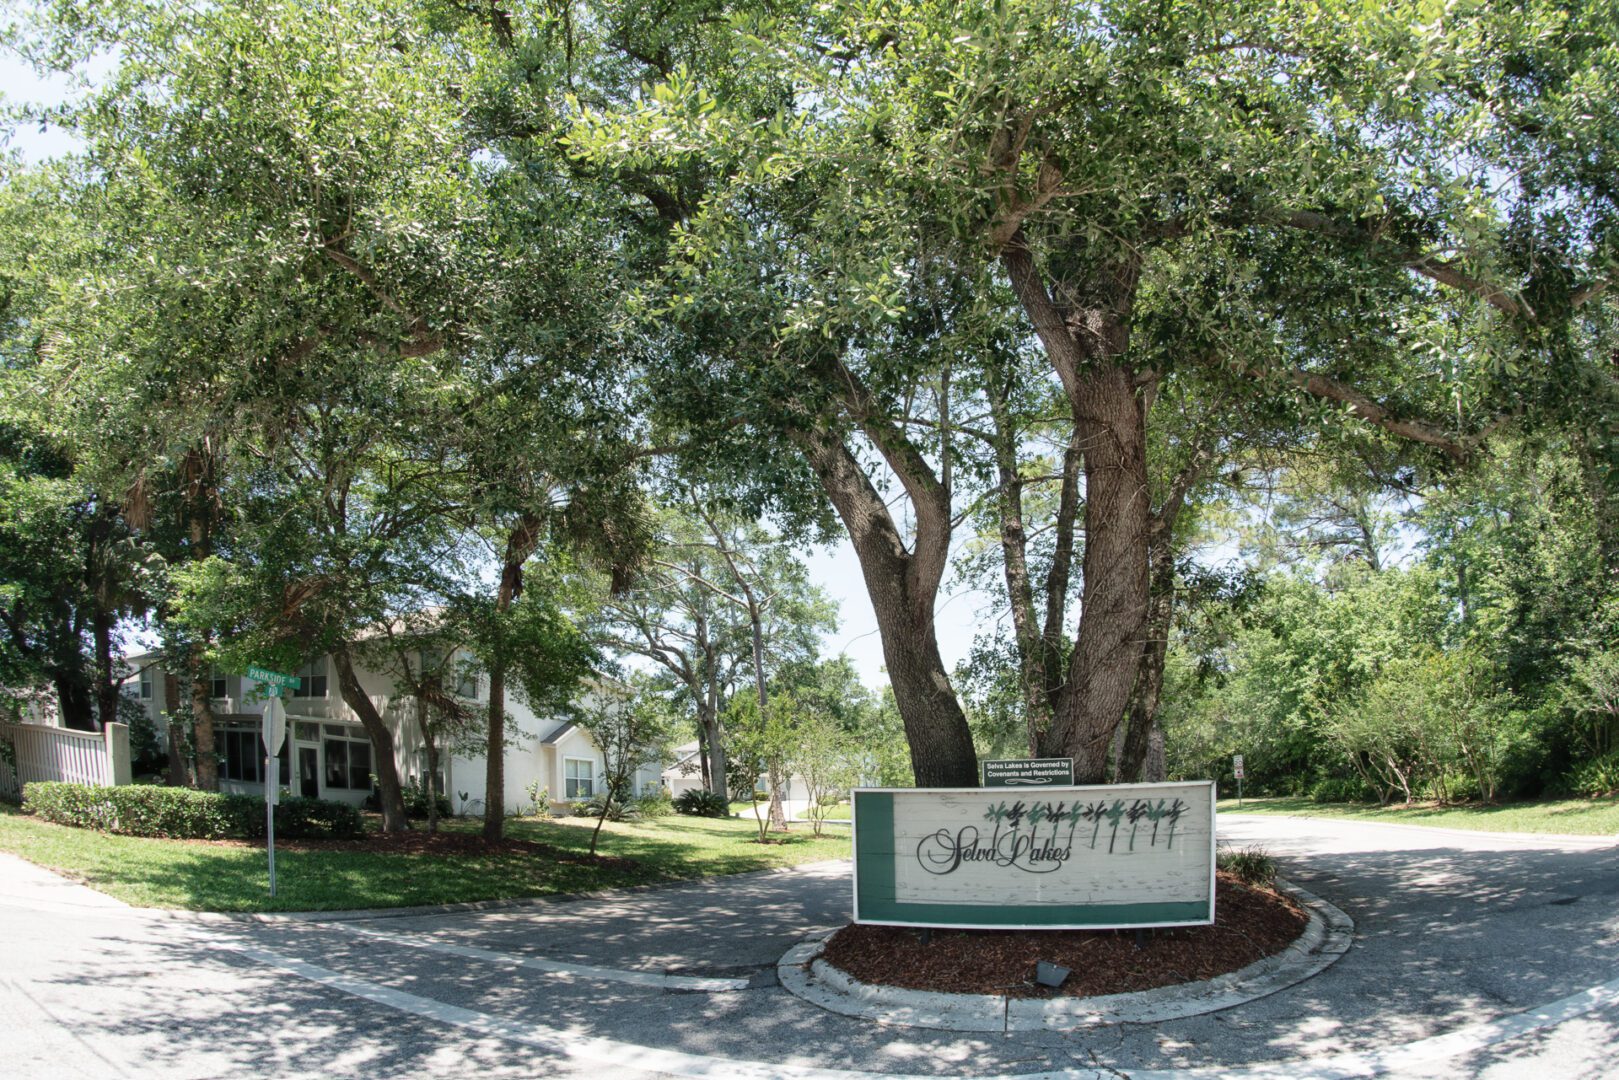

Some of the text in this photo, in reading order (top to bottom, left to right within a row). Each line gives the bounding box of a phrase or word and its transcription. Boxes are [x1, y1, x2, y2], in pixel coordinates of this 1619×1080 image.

[250, 669, 286, 686] PARKSIDE
[1061, 761, 1069, 769] by
[917, 825, 1072, 875] Selva Lakes
